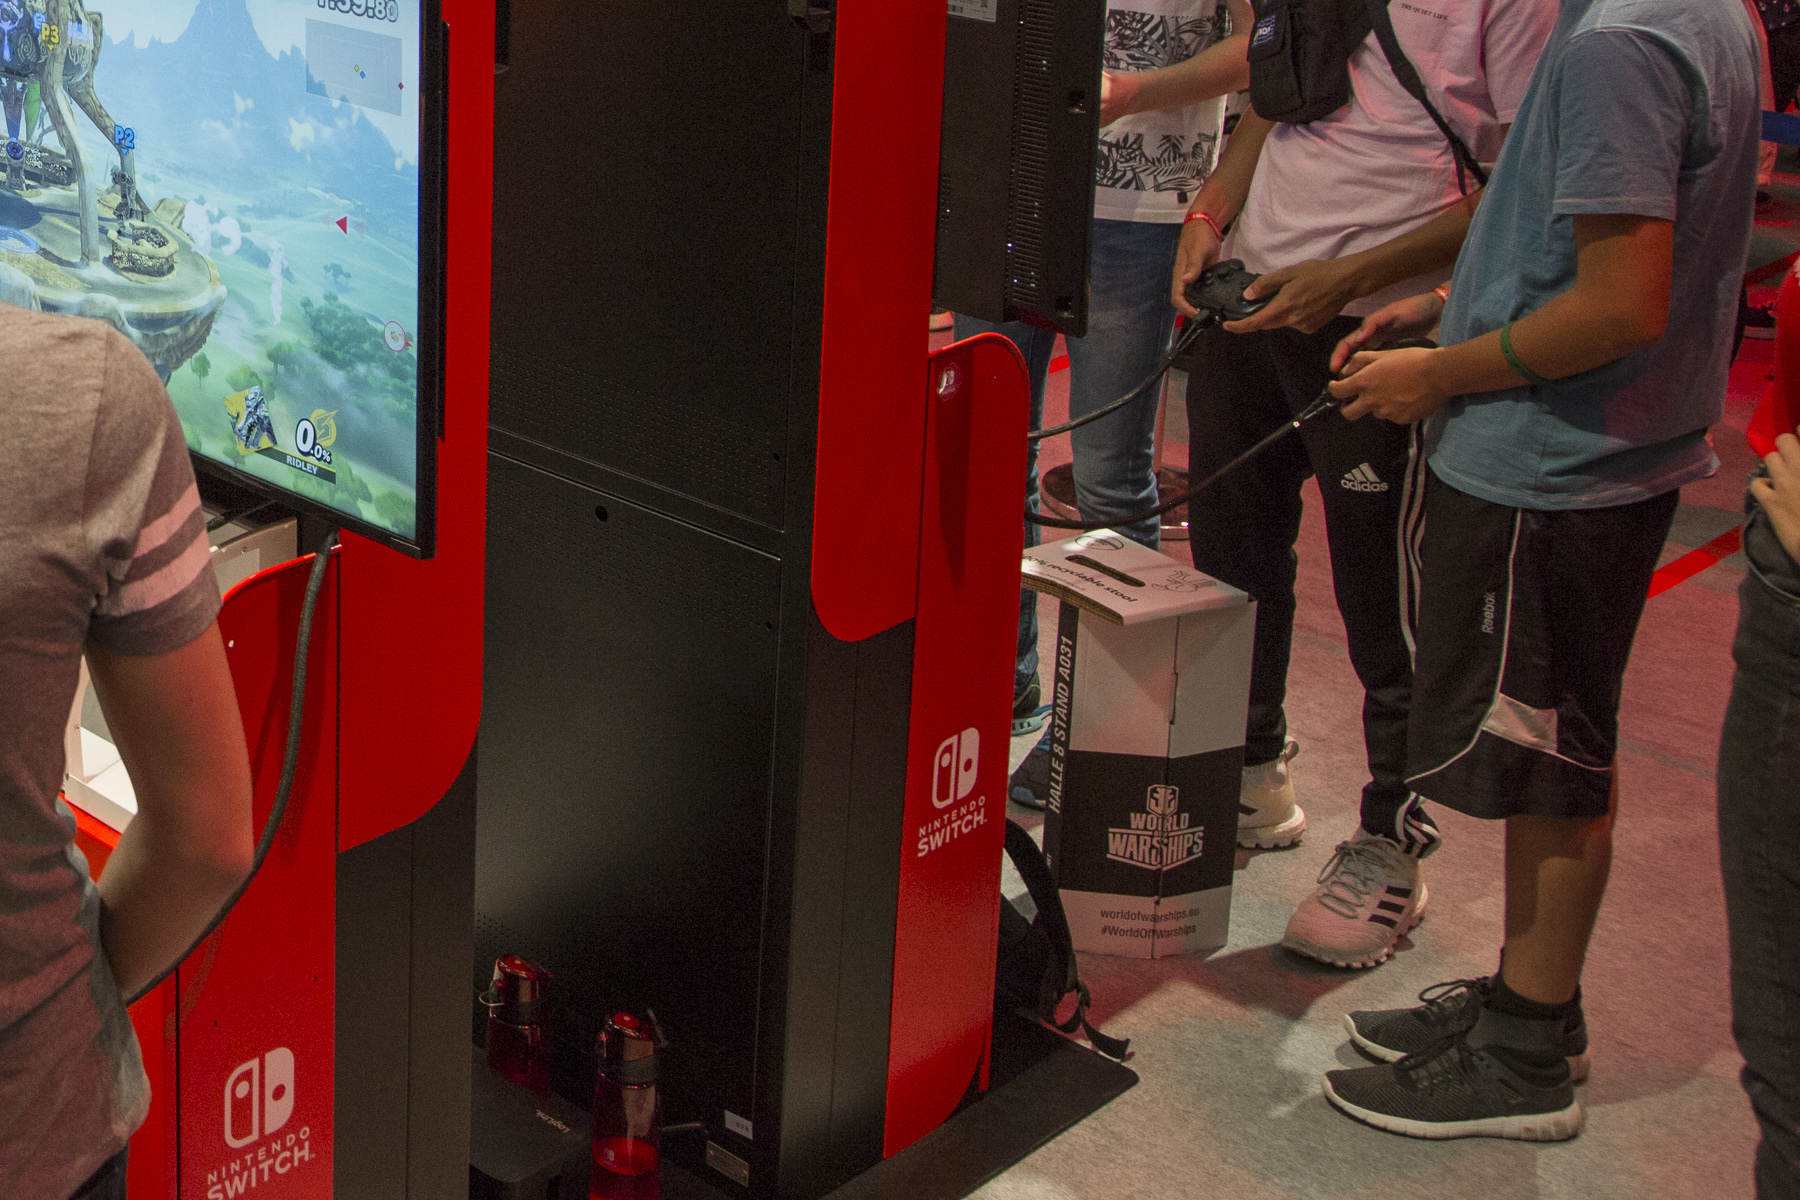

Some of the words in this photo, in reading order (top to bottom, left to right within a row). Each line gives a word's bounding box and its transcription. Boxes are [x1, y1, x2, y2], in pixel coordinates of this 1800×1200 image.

[41, 22, 60, 45] P3
[114, 124, 135, 149] P2
[286, 455, 319, 476] RIDLEY
[1341, 479, 1388, 492] adidas
[1048, 561, 1105, 588] recyclable
[1104, 585, 1138, 604] stool
[1481, 591, 1495, 634] Reebok
[1059, 636, 1073, 682] A031
[1053, 682, 1069, 742] STAND
[1053, 743, 1065, 757] 8
[1048, 756, 1064, 814] HALLE
[917, 807, 985, 858] SWITCH
[919, 795, 986, 838] NINTENDO
[1130, 812, 1189, 831] WORLD
[1108, 831, 1204, 866] WARSHIPS
[207, 1126, 310, 1185] NINTENDO
[207, 1140, 310, 1200] SWITCH
